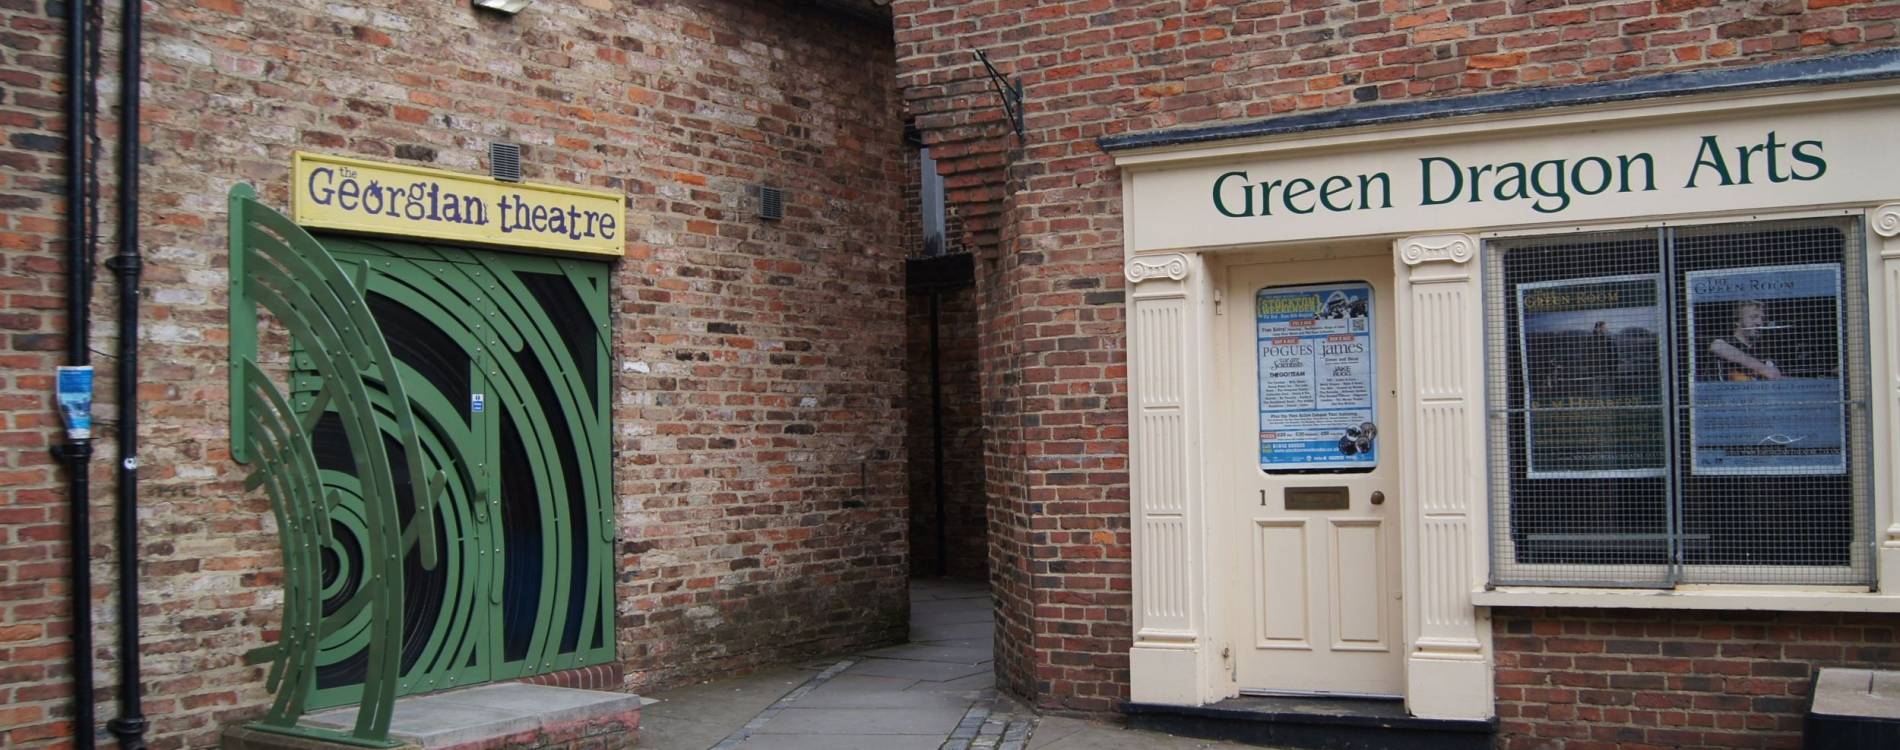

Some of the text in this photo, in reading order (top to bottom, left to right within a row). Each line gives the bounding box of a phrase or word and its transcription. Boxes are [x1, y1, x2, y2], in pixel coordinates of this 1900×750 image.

[339, 166, 357, 179] the
[1212, 130, 1828, 218] Green Dragon Arts
[308, 167, 616, 241] Georgian theatre
[1263, 345, 1313, 357] POGUES
[1321, 341, 1364, 358] james
[1259, 489, 1267, 506] 1
